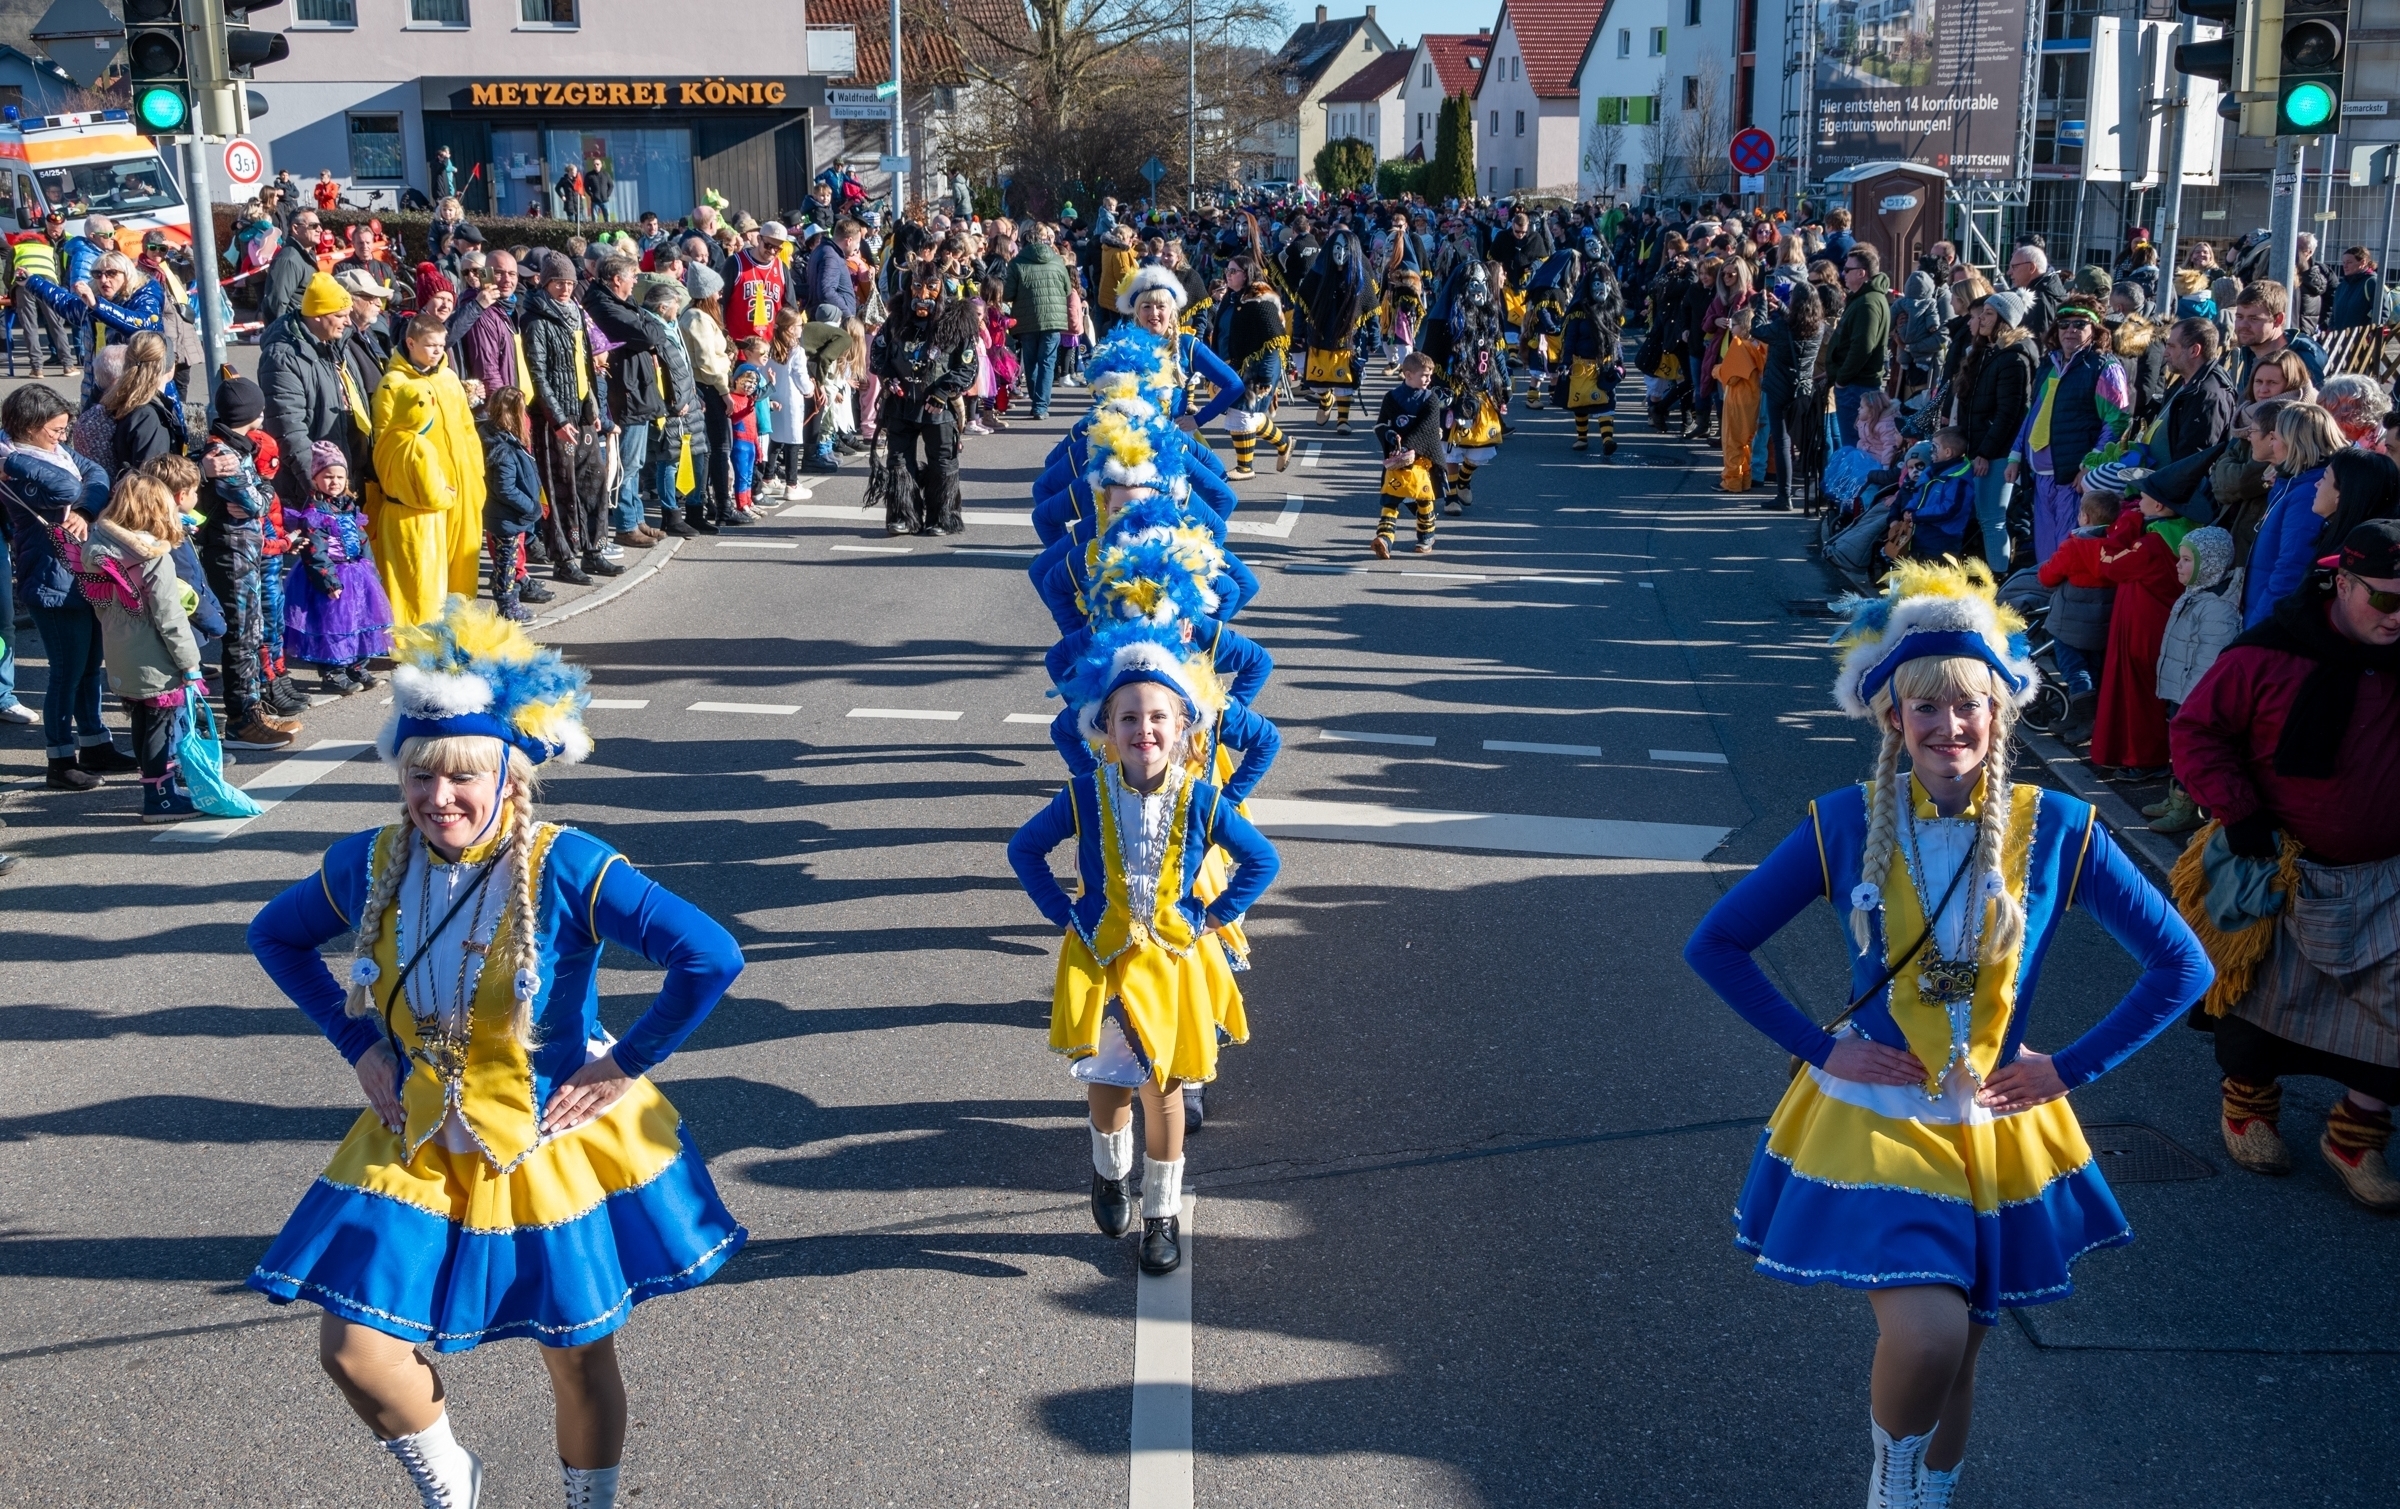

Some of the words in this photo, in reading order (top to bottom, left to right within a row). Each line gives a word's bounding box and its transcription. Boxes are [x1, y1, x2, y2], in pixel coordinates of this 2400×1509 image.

[471, 83, 667, 106] METZGEREI
[680, 77, 787, 105] KÖNIG
[1819, 99, 1842, 114] Hier
[1844, 97, 1901, 113] entstehen
[1905, 97, 1918, 112] 14
[1921, 94, 1999, 111] komfortable
[2342, 104, 2384, 112] Bismarckstr.
[835, 108, 864, 117] Böblinger
[1818, 115, 1951, 136] Eigentumswohnungen!
[1950, 155, 2010, 166] BRUTSCHIN
[743, 280, 780, 302] BULS
[1311, 366, 1324, 377] 19
[1389, 478, 1402, 491] 12
